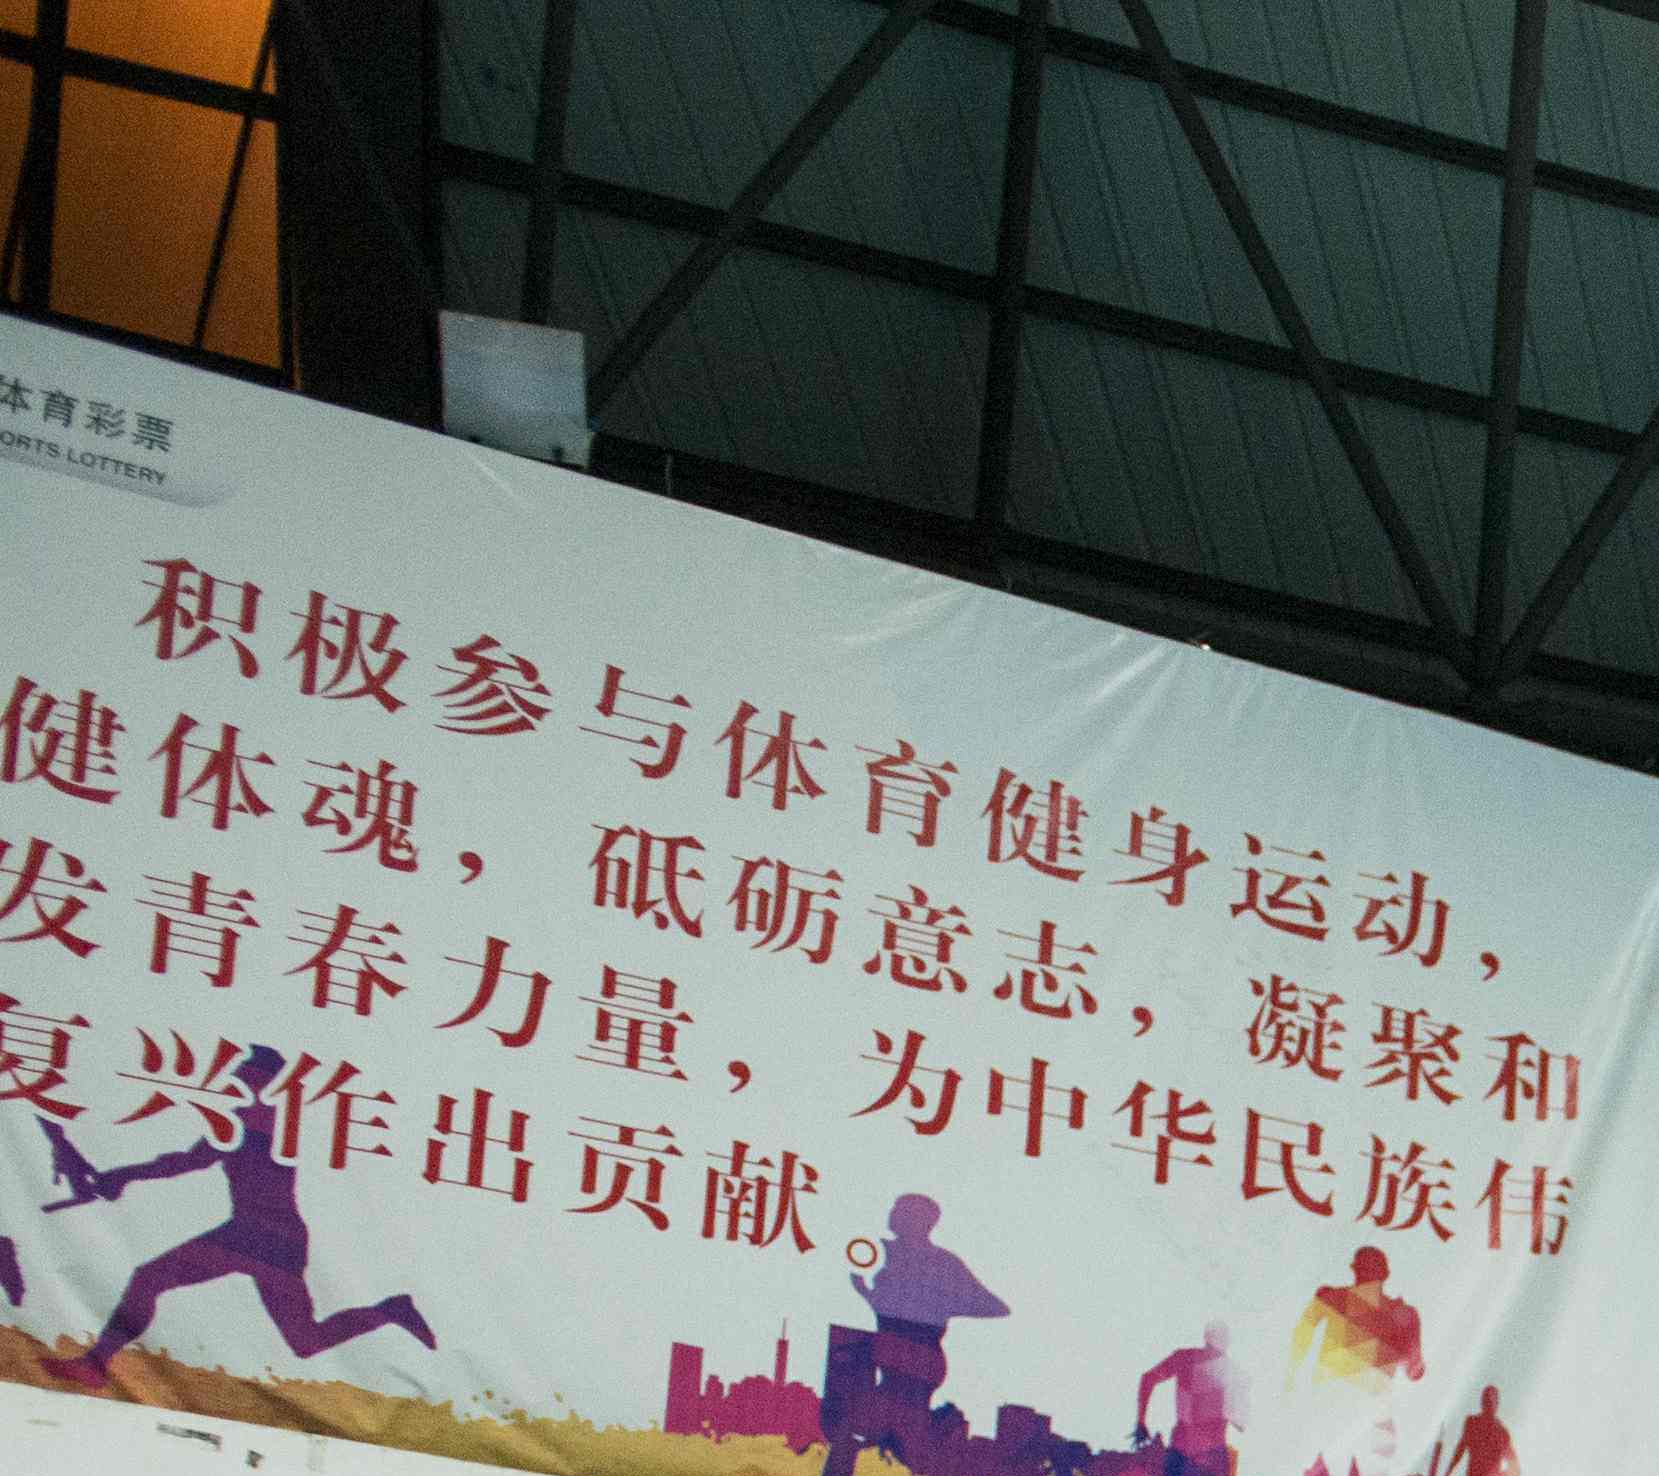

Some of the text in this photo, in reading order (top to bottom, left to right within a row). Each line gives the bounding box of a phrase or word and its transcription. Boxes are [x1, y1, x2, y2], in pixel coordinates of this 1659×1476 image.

[0, 374, 174, 452] 体育彩票
[0, 430, 166, 485] ORTS LOTTERY
[135, 557, 1500, 981] 积极参与体育健身运动，
